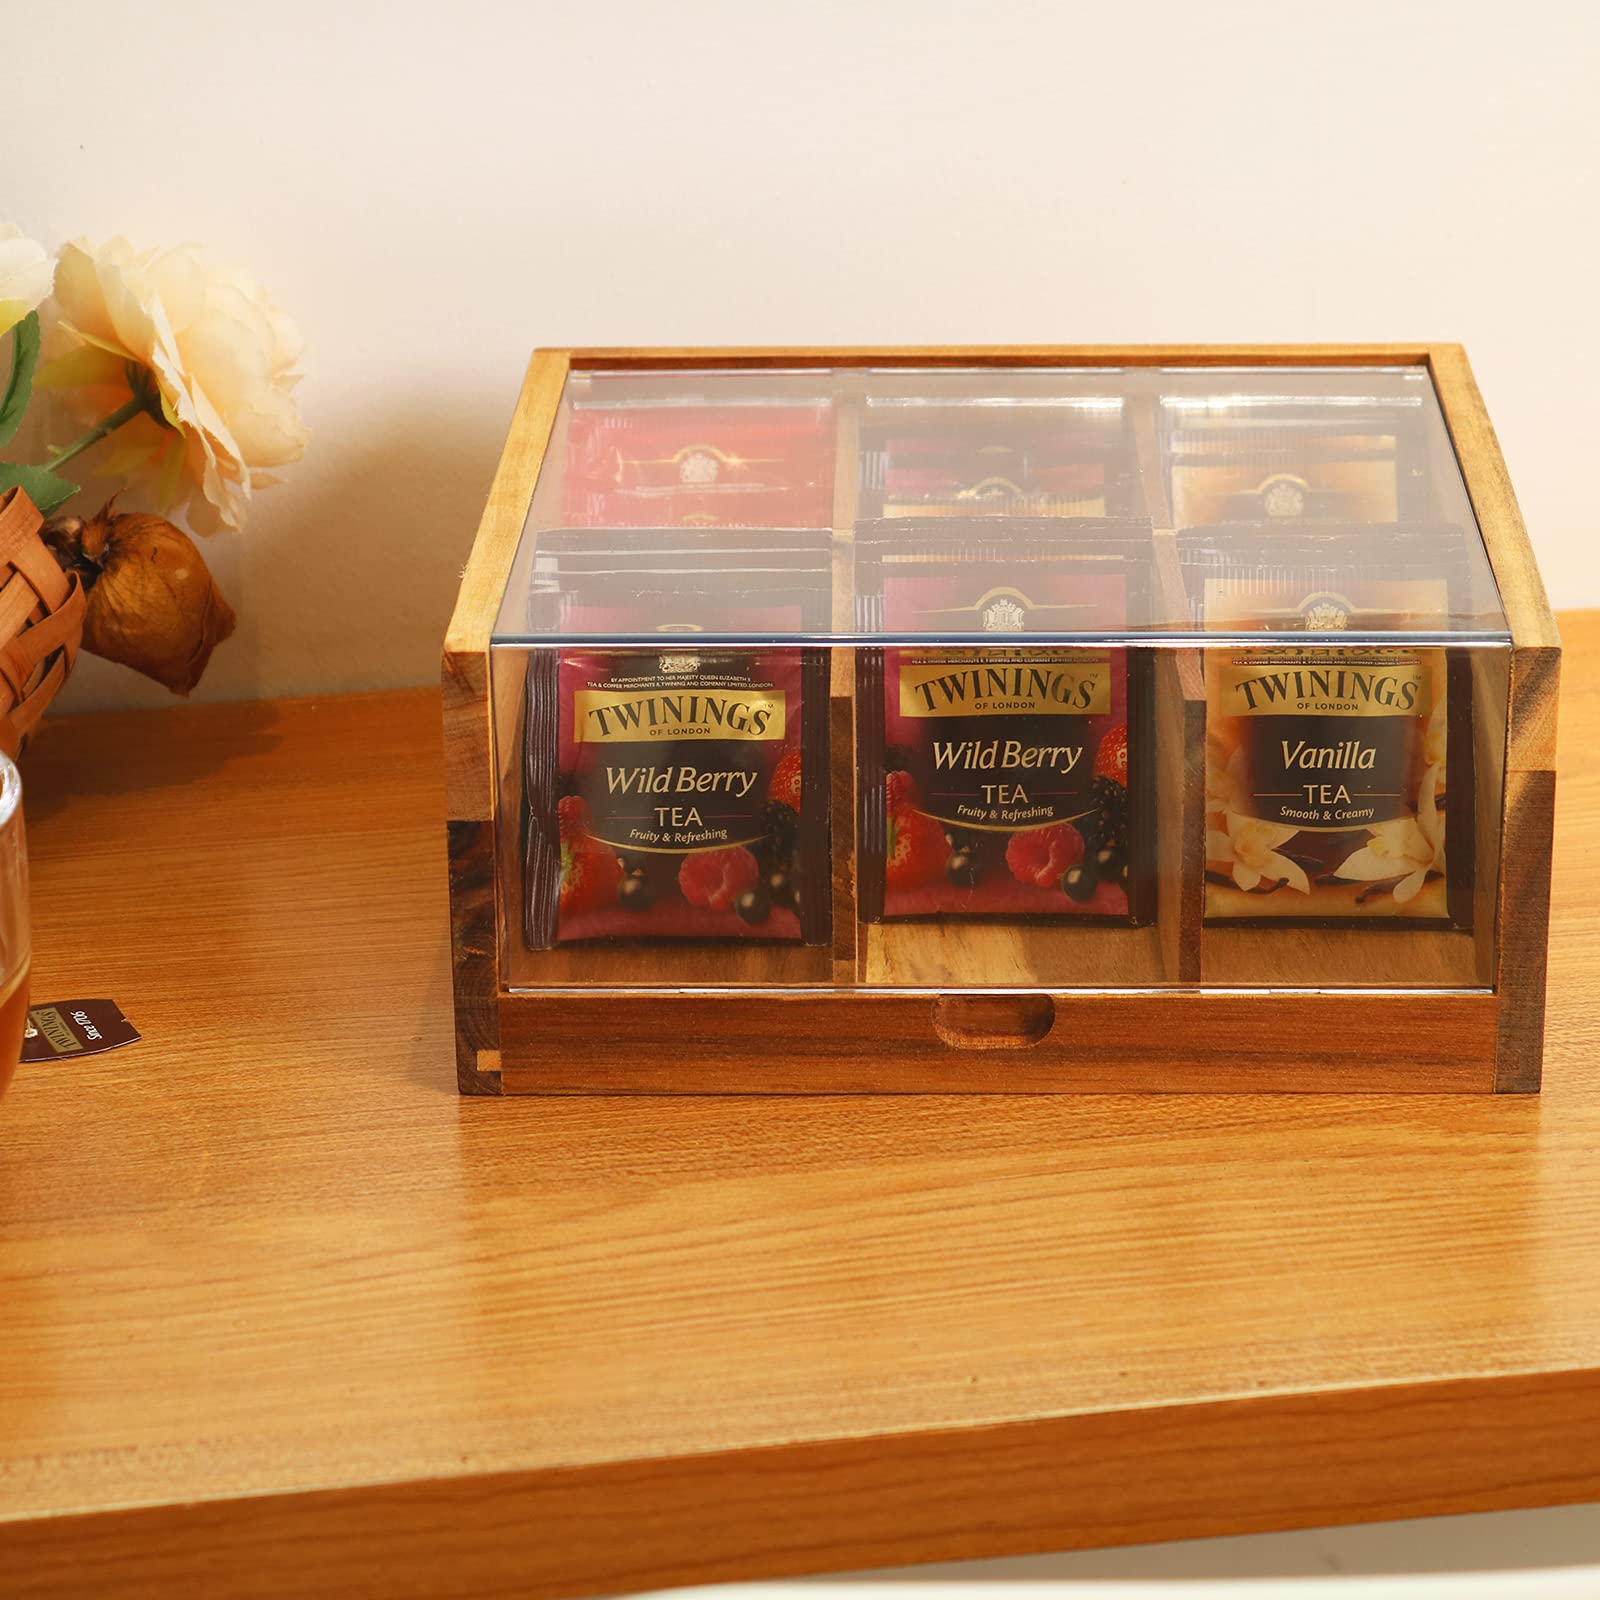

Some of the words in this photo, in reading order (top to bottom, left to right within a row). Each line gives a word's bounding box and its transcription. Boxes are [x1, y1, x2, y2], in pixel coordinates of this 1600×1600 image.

[914, 667, 1096, 711] TWININGS
[1235, 670, 1419, 710] TWININGS
[588, 695, 771, 736] TWININGS
[975, 702, 988, 710] OF
[1297, 702, 1310, 710] OF
[1315, 702, 1358, 710] LONDON
[668, 727, 710, 735] LONDON
[933, 740, 999, 770] Wild
[1001, 740, 1083, 774] Berry
[1282, 740, 1376, 770] Vanilla
[606, 766, 673, 794] Wild
[675, 766, 758, 798] Berry
[981, 784, 1029, 804] TEA
[1303, 784, 1351, 804] TEA
[654, 807, 703, 827] TEA
[957, 804, 987, 820] Fruity
[989, 809, 998, 819] &
[1001, 805, 1053, 822] Refreshing
[1280, 806, 1319, 820] Smooth
[1323, 810, 1331, 820] &
[1335, 807, 1375, 819] Creamy
[629, 828, 660, 843] Fruity
[662, 832, 671, 841] &
[674, 829, 727, 844] Refreshing
